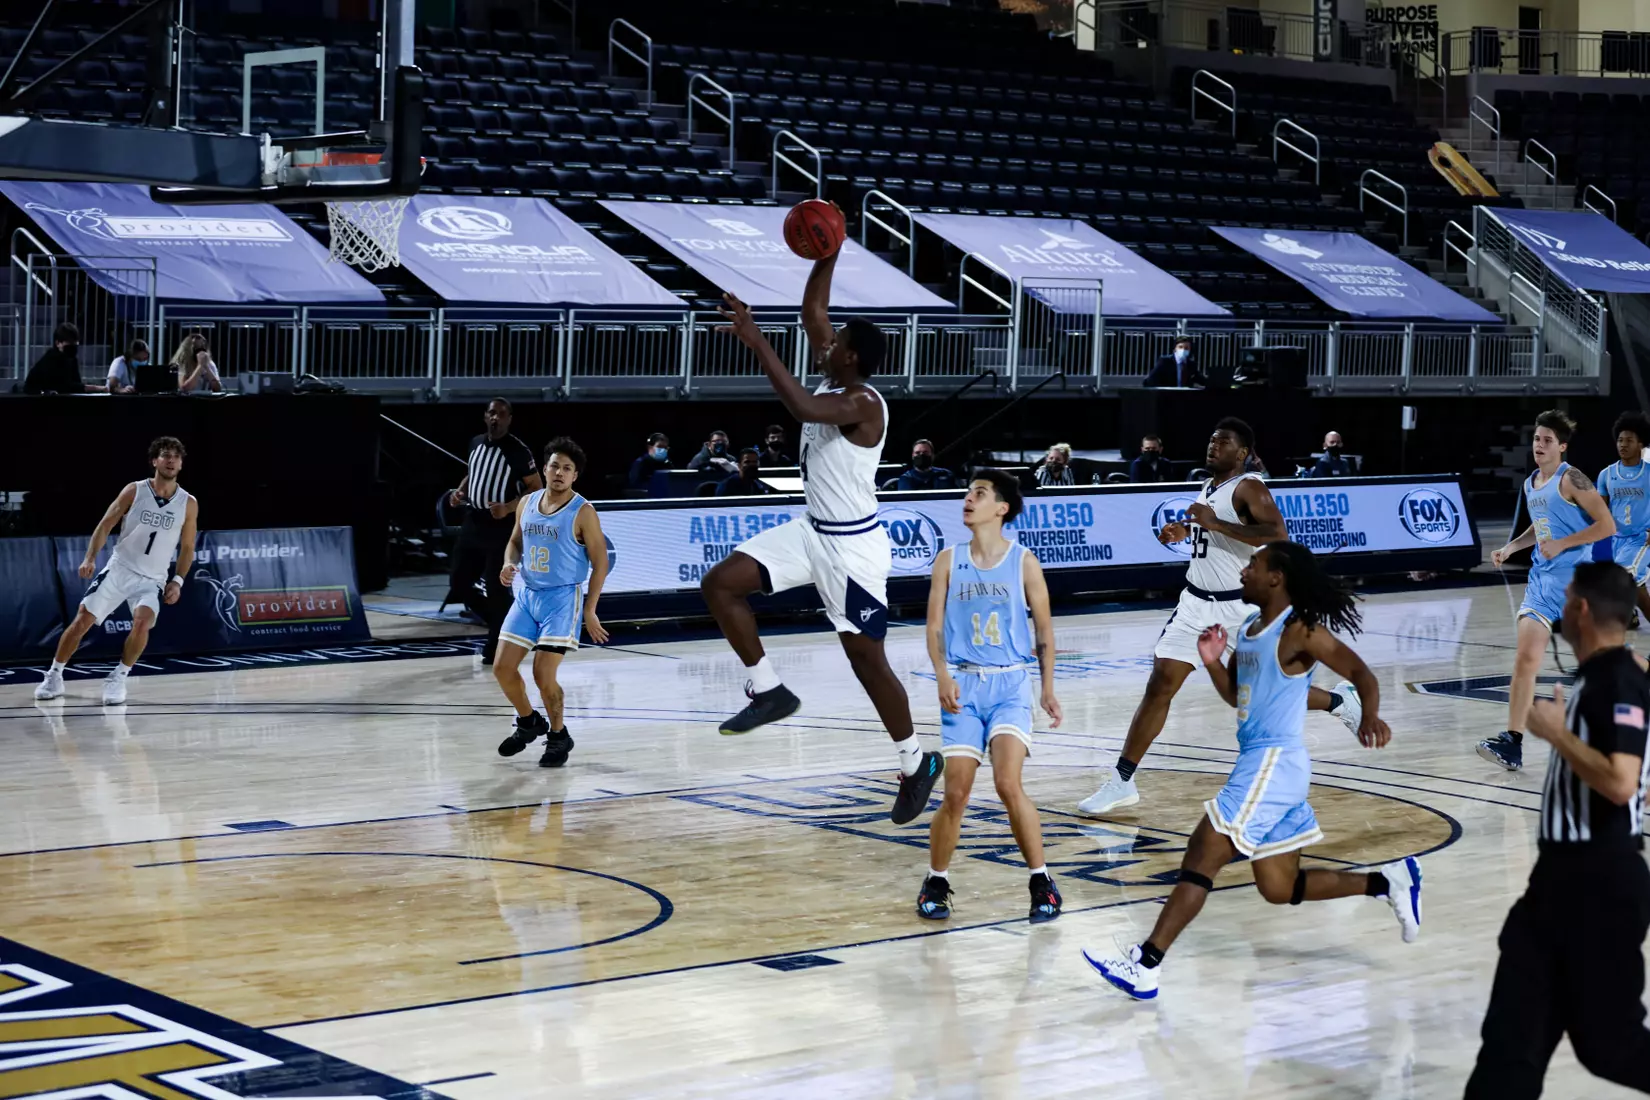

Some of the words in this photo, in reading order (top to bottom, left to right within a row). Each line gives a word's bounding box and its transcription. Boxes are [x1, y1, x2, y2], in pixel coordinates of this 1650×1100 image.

[1365, 5, 1438, 22] PURPOSE
[120, 221, 265, 234] provider
[415, 242, 590, 256] MAGNOLIA
[1000, 244, 1124, 267] Altura
[1275, 493, 1350, 518] AM1350
[1408, 498, 1448, 523] FOX
[1624, 504, 1632, 525] 1
[140, 510, 175, 530] CBU
[1286, 518, 1344, 534] RIVERSIDE
[1414, 522, 1451, 533] SPORTS
[522, 522, 560, 539] HAWKS
[1018, 529, 1086, 547] RIVERSIDE
[144, 531, 157, 555] 1
[1191, 526, 1209, 559] 35
[217, 544, 304, 560] Provider.
[529, 545, 550, 573] 12
[891, 547, 931, 559] PORTS
[955, 582, 1010, 601] HAWKS
[245, 598, 339, 617] provider
[115, 620, 133, 631] CB
[250, 626, 286, 635] contract
[289, 625, 310, 633] food
[311, 624, 342, 632] service
[971, 611, 1002, 646] 14
